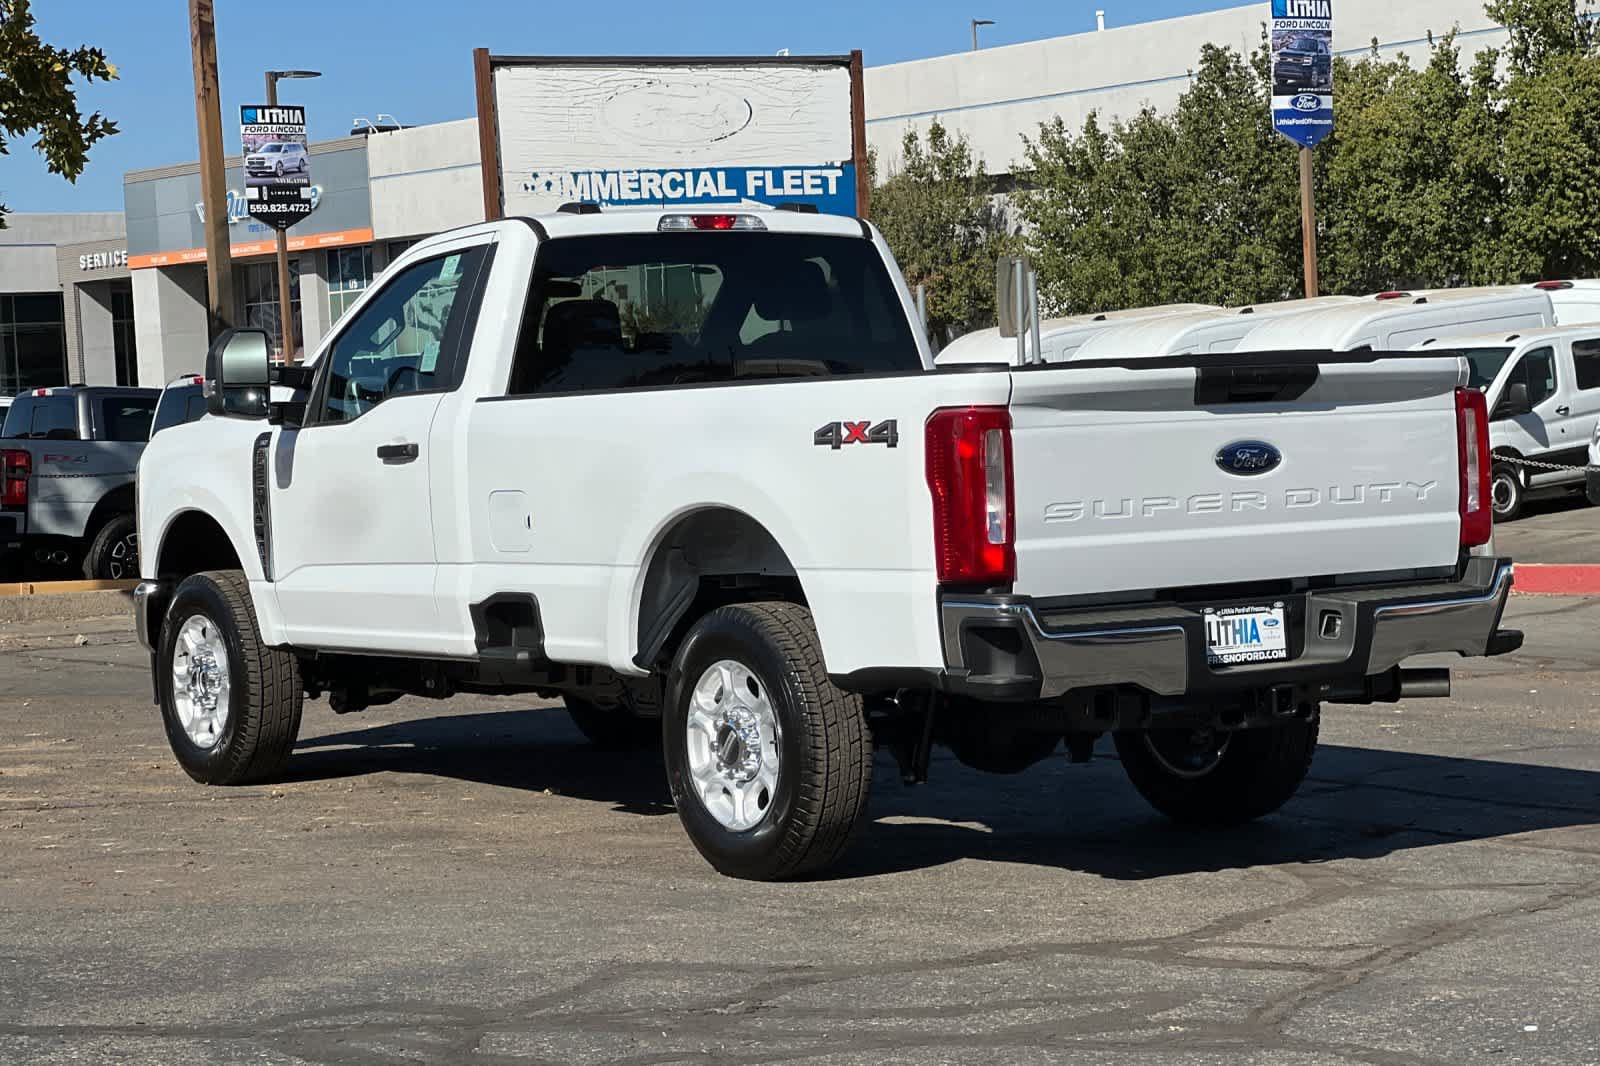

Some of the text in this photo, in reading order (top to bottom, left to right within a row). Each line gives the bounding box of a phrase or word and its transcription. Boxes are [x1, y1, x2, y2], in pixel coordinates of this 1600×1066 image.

[1287, 0, 1330, 17] LITHIA
[1274, 20, 1331, 28] FORD LINCOLN
[1296, 95, 1318, 109] Ford
[256, 109, 303, 124] LITHIA
[746, 168, 843, 196] FLEET
[250, 203, 310, 213] 559.825.4722
[79, 250, 128, 269] SERVICE
[1232, 448, 1268, 468] Ford
[1043, 480, 1439, 525] SUPER DUTY
[1208, 617, 1261, 646] LITHIA
